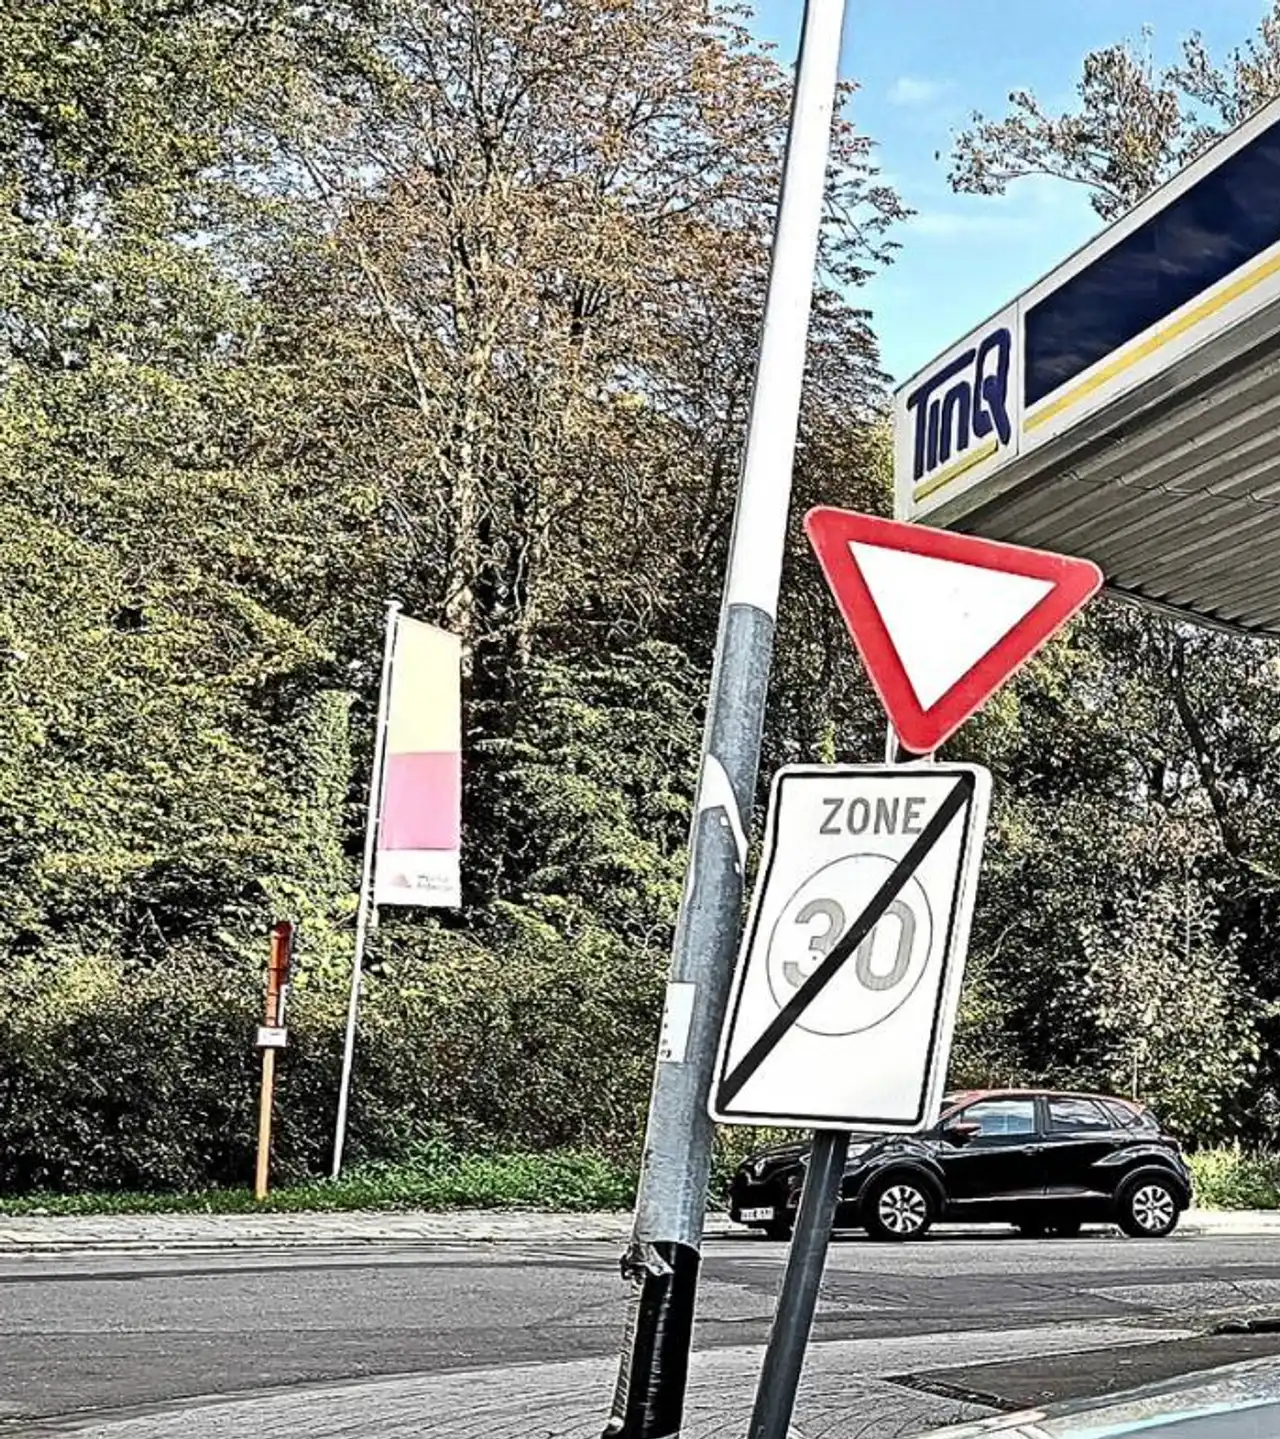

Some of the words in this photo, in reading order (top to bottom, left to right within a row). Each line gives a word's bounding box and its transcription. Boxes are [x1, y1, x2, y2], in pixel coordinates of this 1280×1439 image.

[906, 326, 1012, 482] TinQ
[819, 796, 927, 837] ZONE
[782, 897, 917, 993] 30
